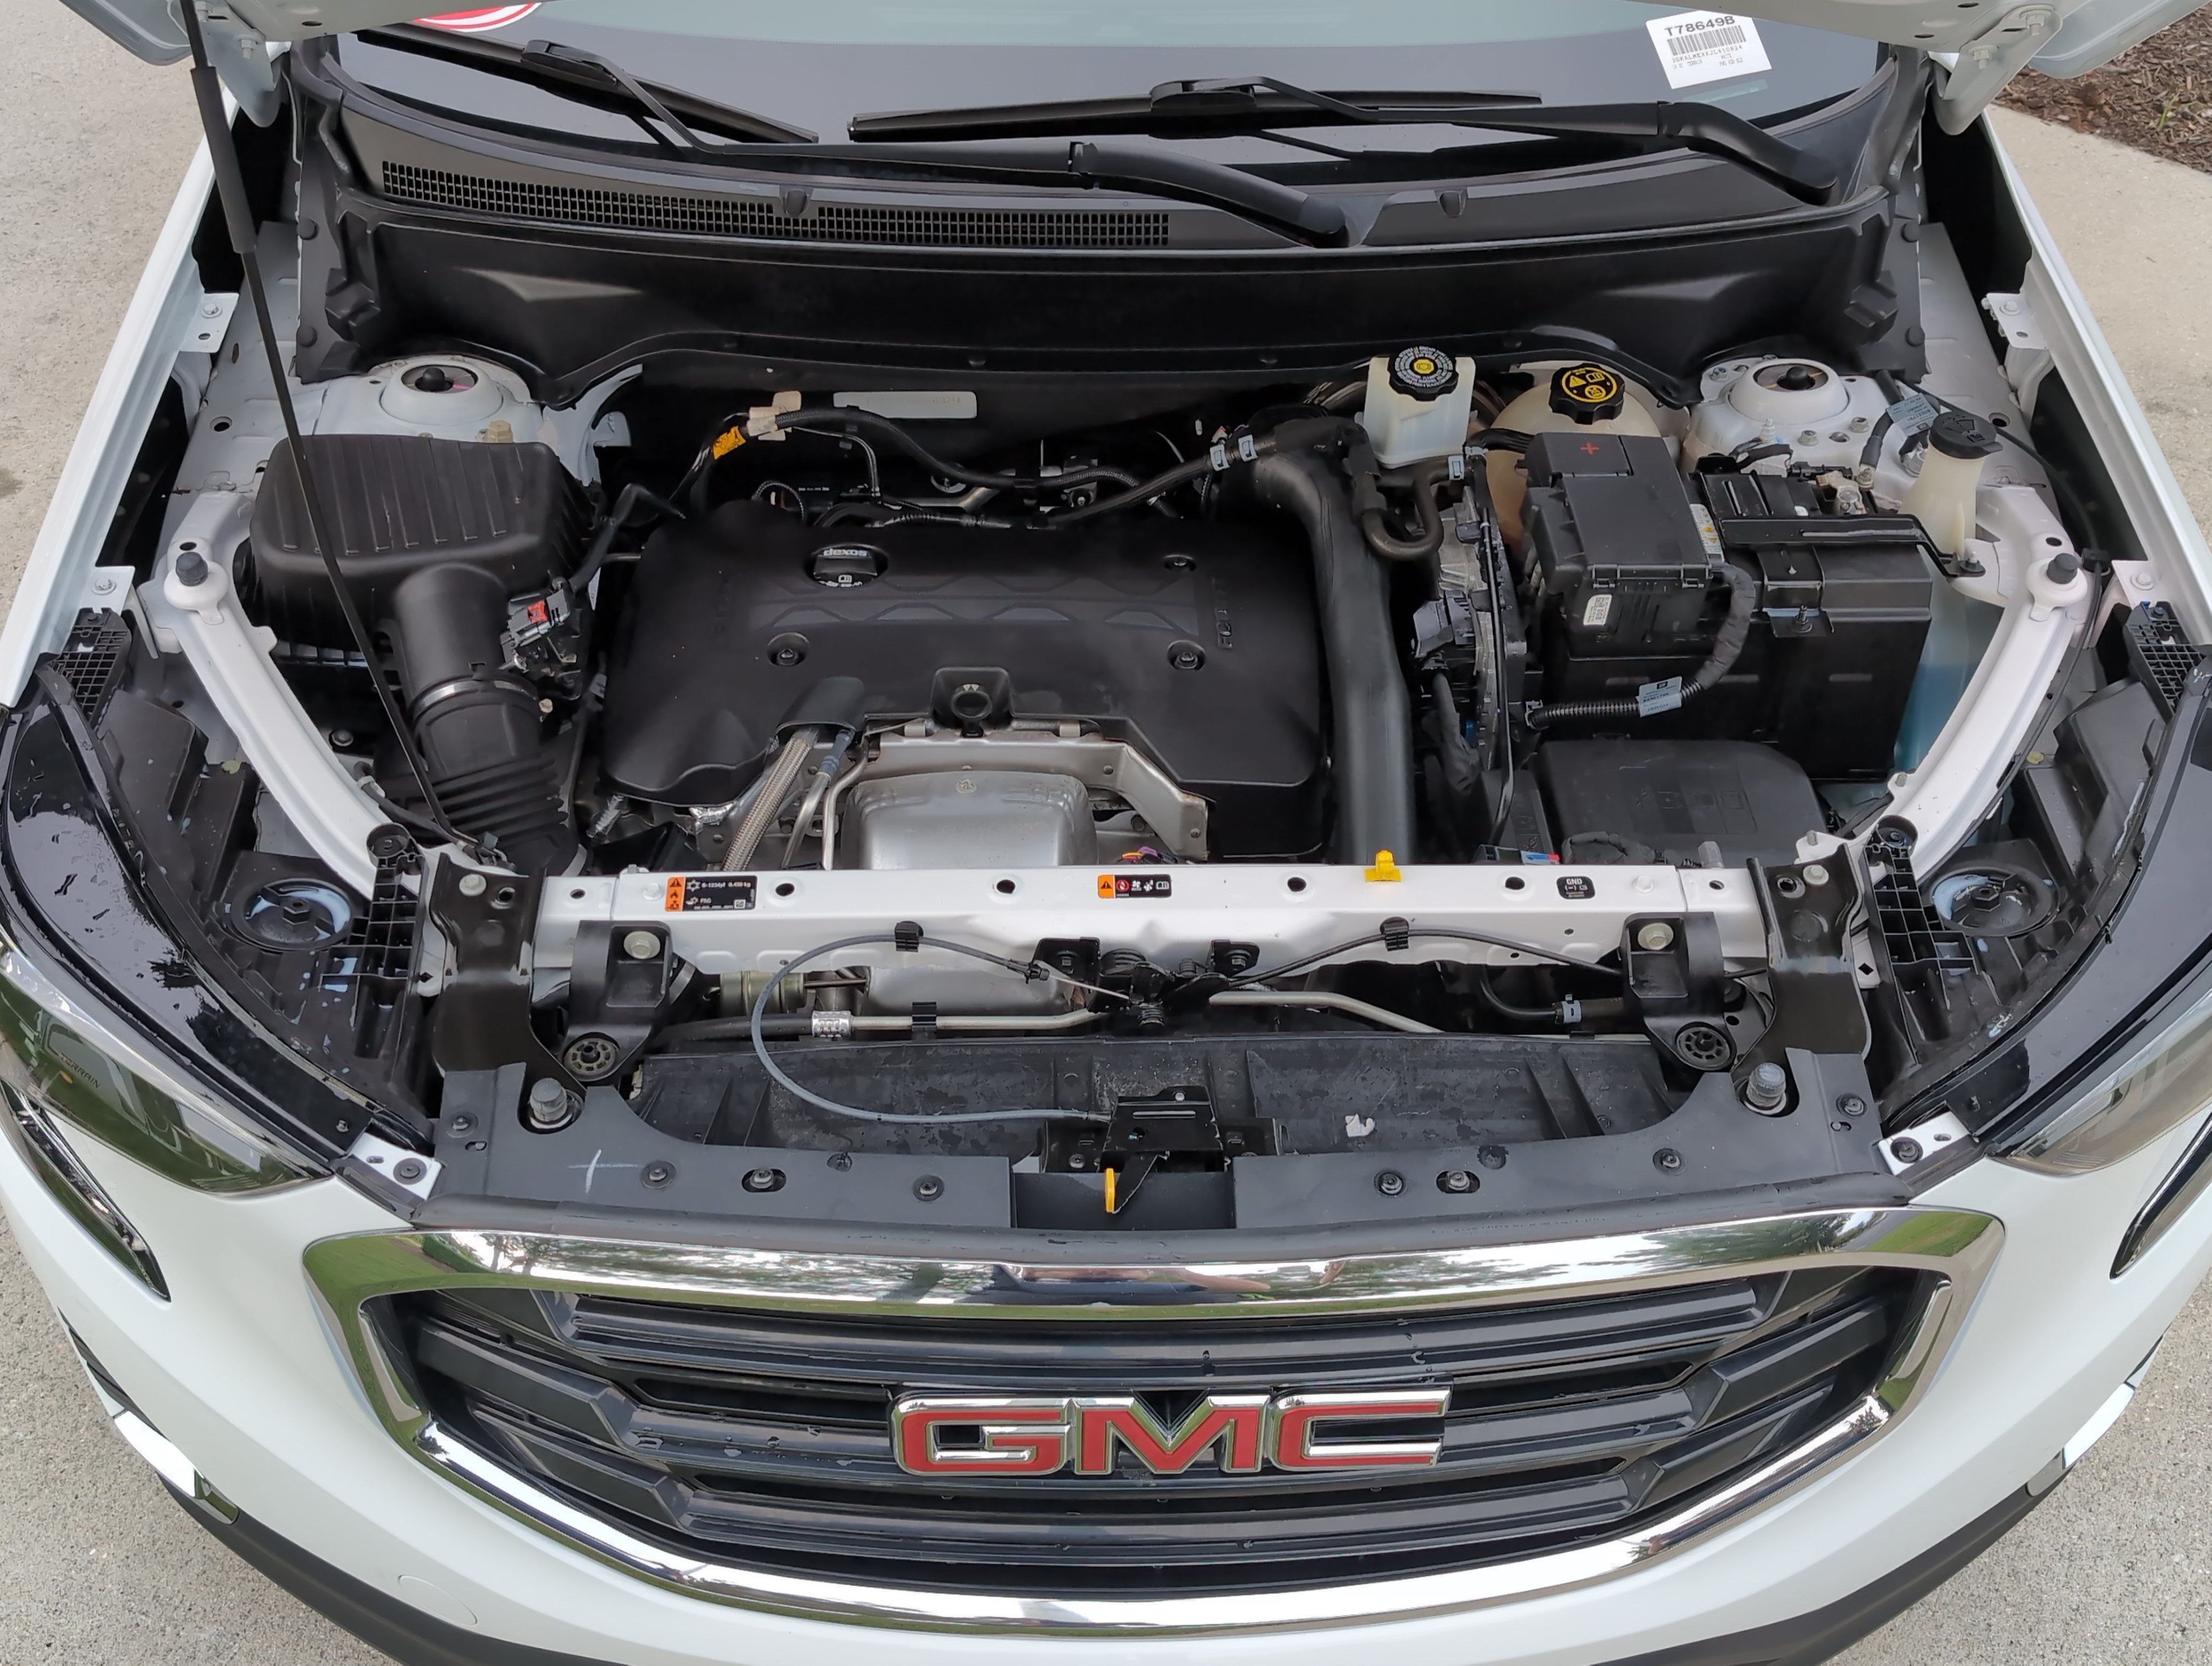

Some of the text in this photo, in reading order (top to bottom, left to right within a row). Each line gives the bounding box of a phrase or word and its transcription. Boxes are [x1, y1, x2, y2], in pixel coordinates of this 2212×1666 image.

[1664, 15, 1735, 36] T78649B
[823, 548, 869, 556] dexos
[60, 1052, 101, 1088] TERRAIN
[891, 1388, 1451, 1475] GMC
